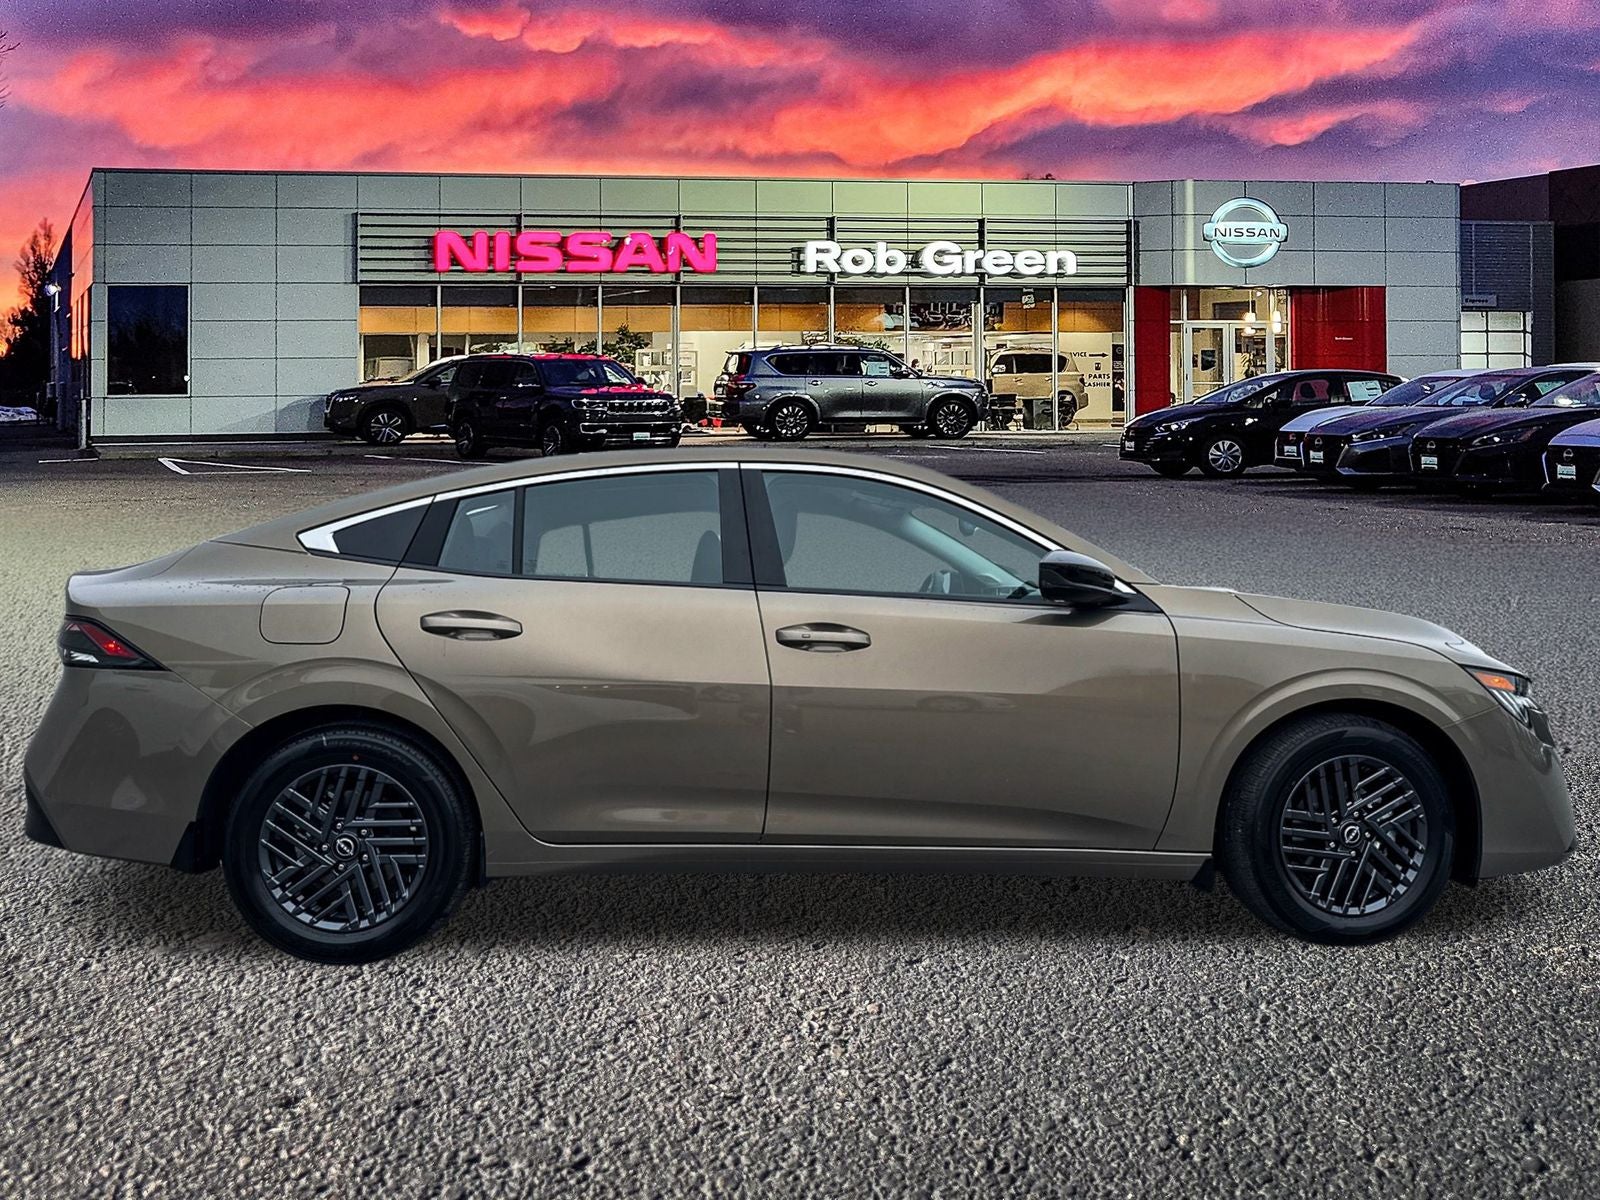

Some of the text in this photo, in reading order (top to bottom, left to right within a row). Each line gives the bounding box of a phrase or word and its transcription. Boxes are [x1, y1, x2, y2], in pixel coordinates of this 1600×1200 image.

[1214, 227, 1281, 238] NISSAN
[433, 230, 718, 274] NISSAN
[804, 240, 1078, 276] Rob Green
